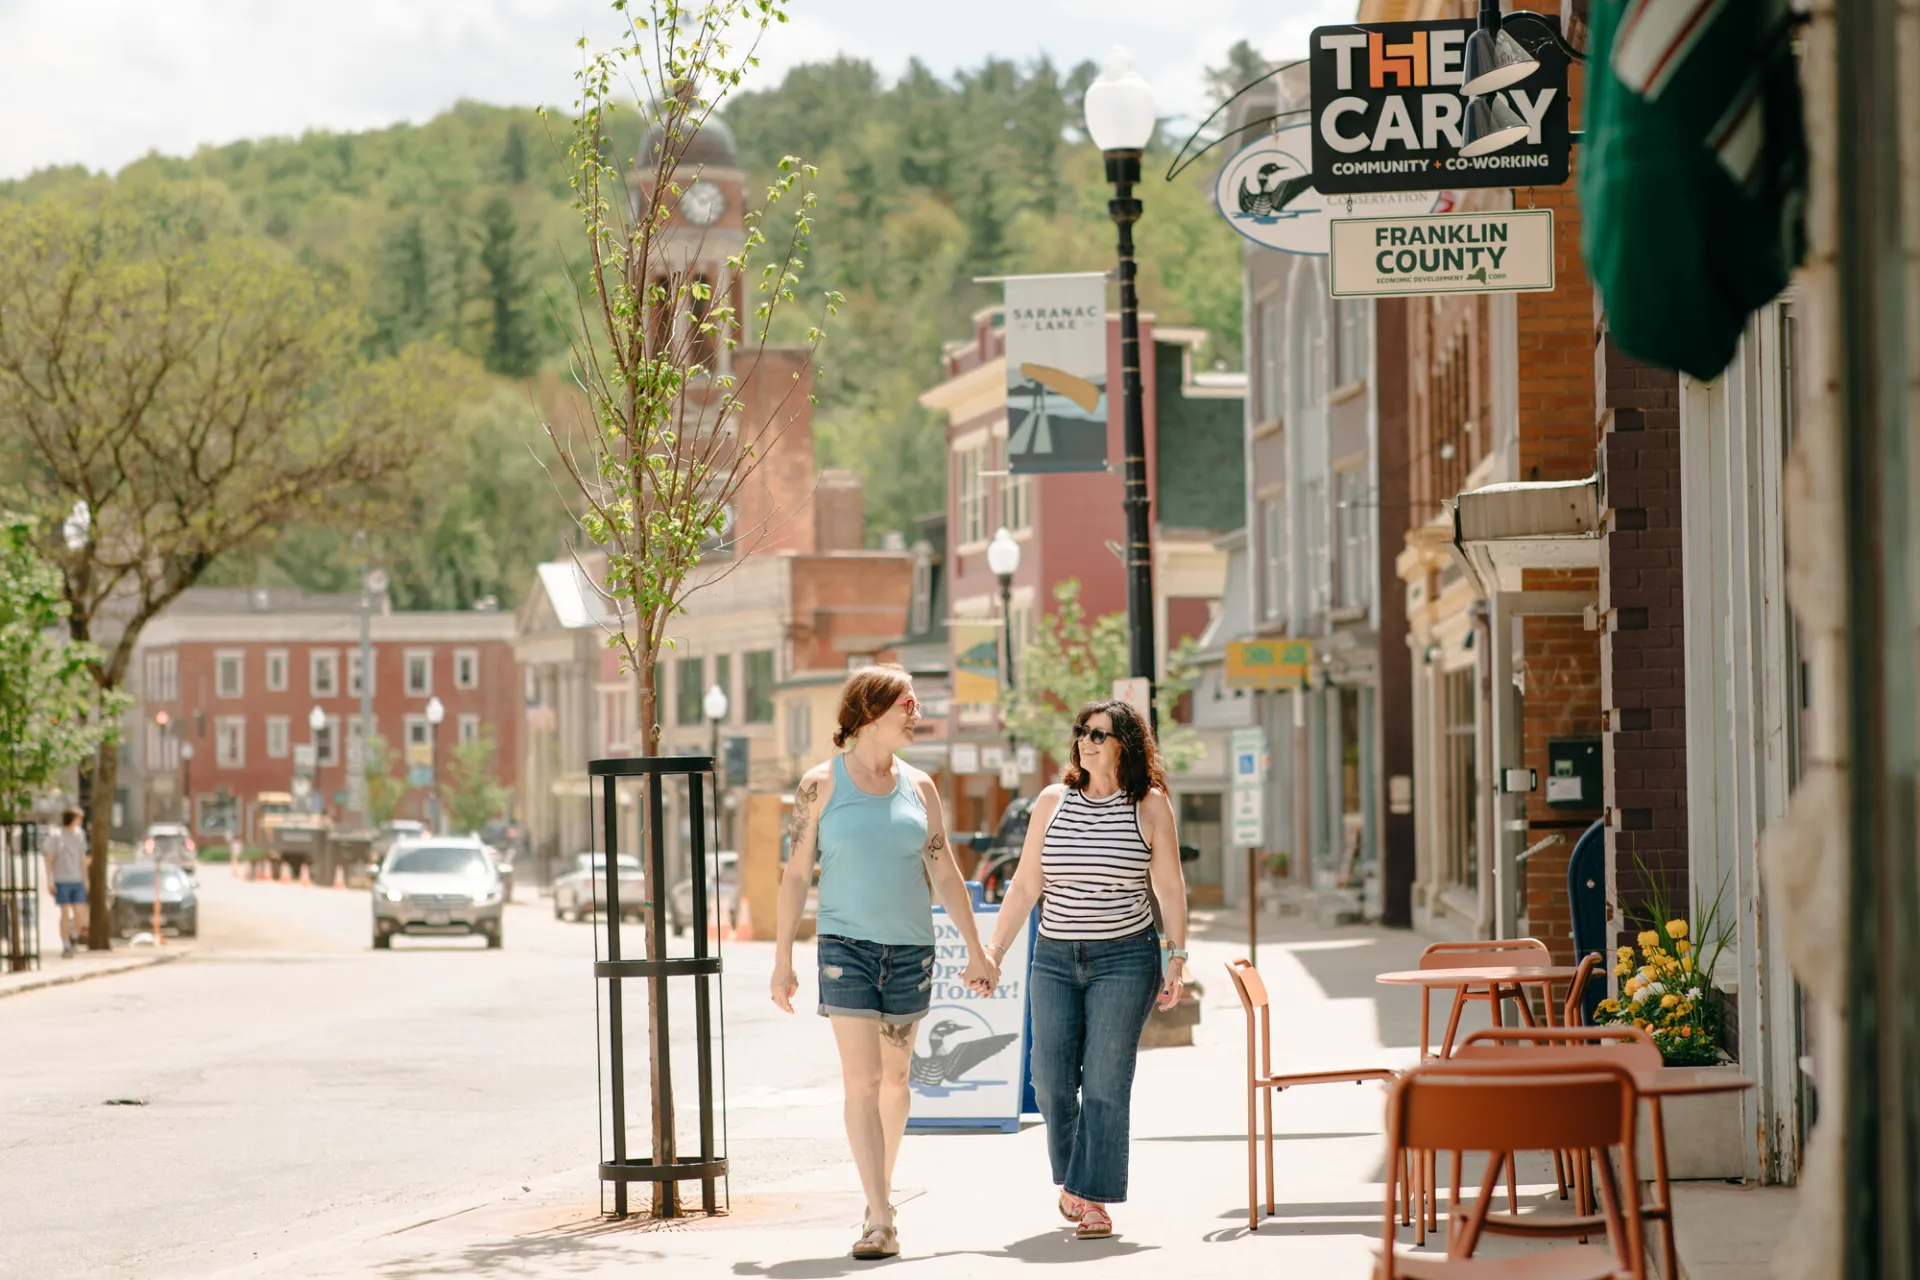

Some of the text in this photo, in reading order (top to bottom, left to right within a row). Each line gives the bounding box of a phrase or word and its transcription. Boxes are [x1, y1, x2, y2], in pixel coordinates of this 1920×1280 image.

[1320, 29, 1465, 90] THE
[1320, 88, 1558, 154] CARY
[1332, 159, 1430, 176] COMMUNITY
[1445, 154, 1549, 171] CO-WORKING
[1326, 192, 1428, 207] CONSERVATION
[1375, 222, 1508, 247] FRANKLIN
[1375, 246, 1508, 275] COUNTY
[1376, 276, 1412, 284] ECONOMIC
[1413, 274, 1464, 283] DEVELOPMENT
[1012, 305, 1098, 320] SARANAC
[1034, 320, 1076, 332] LAKE
